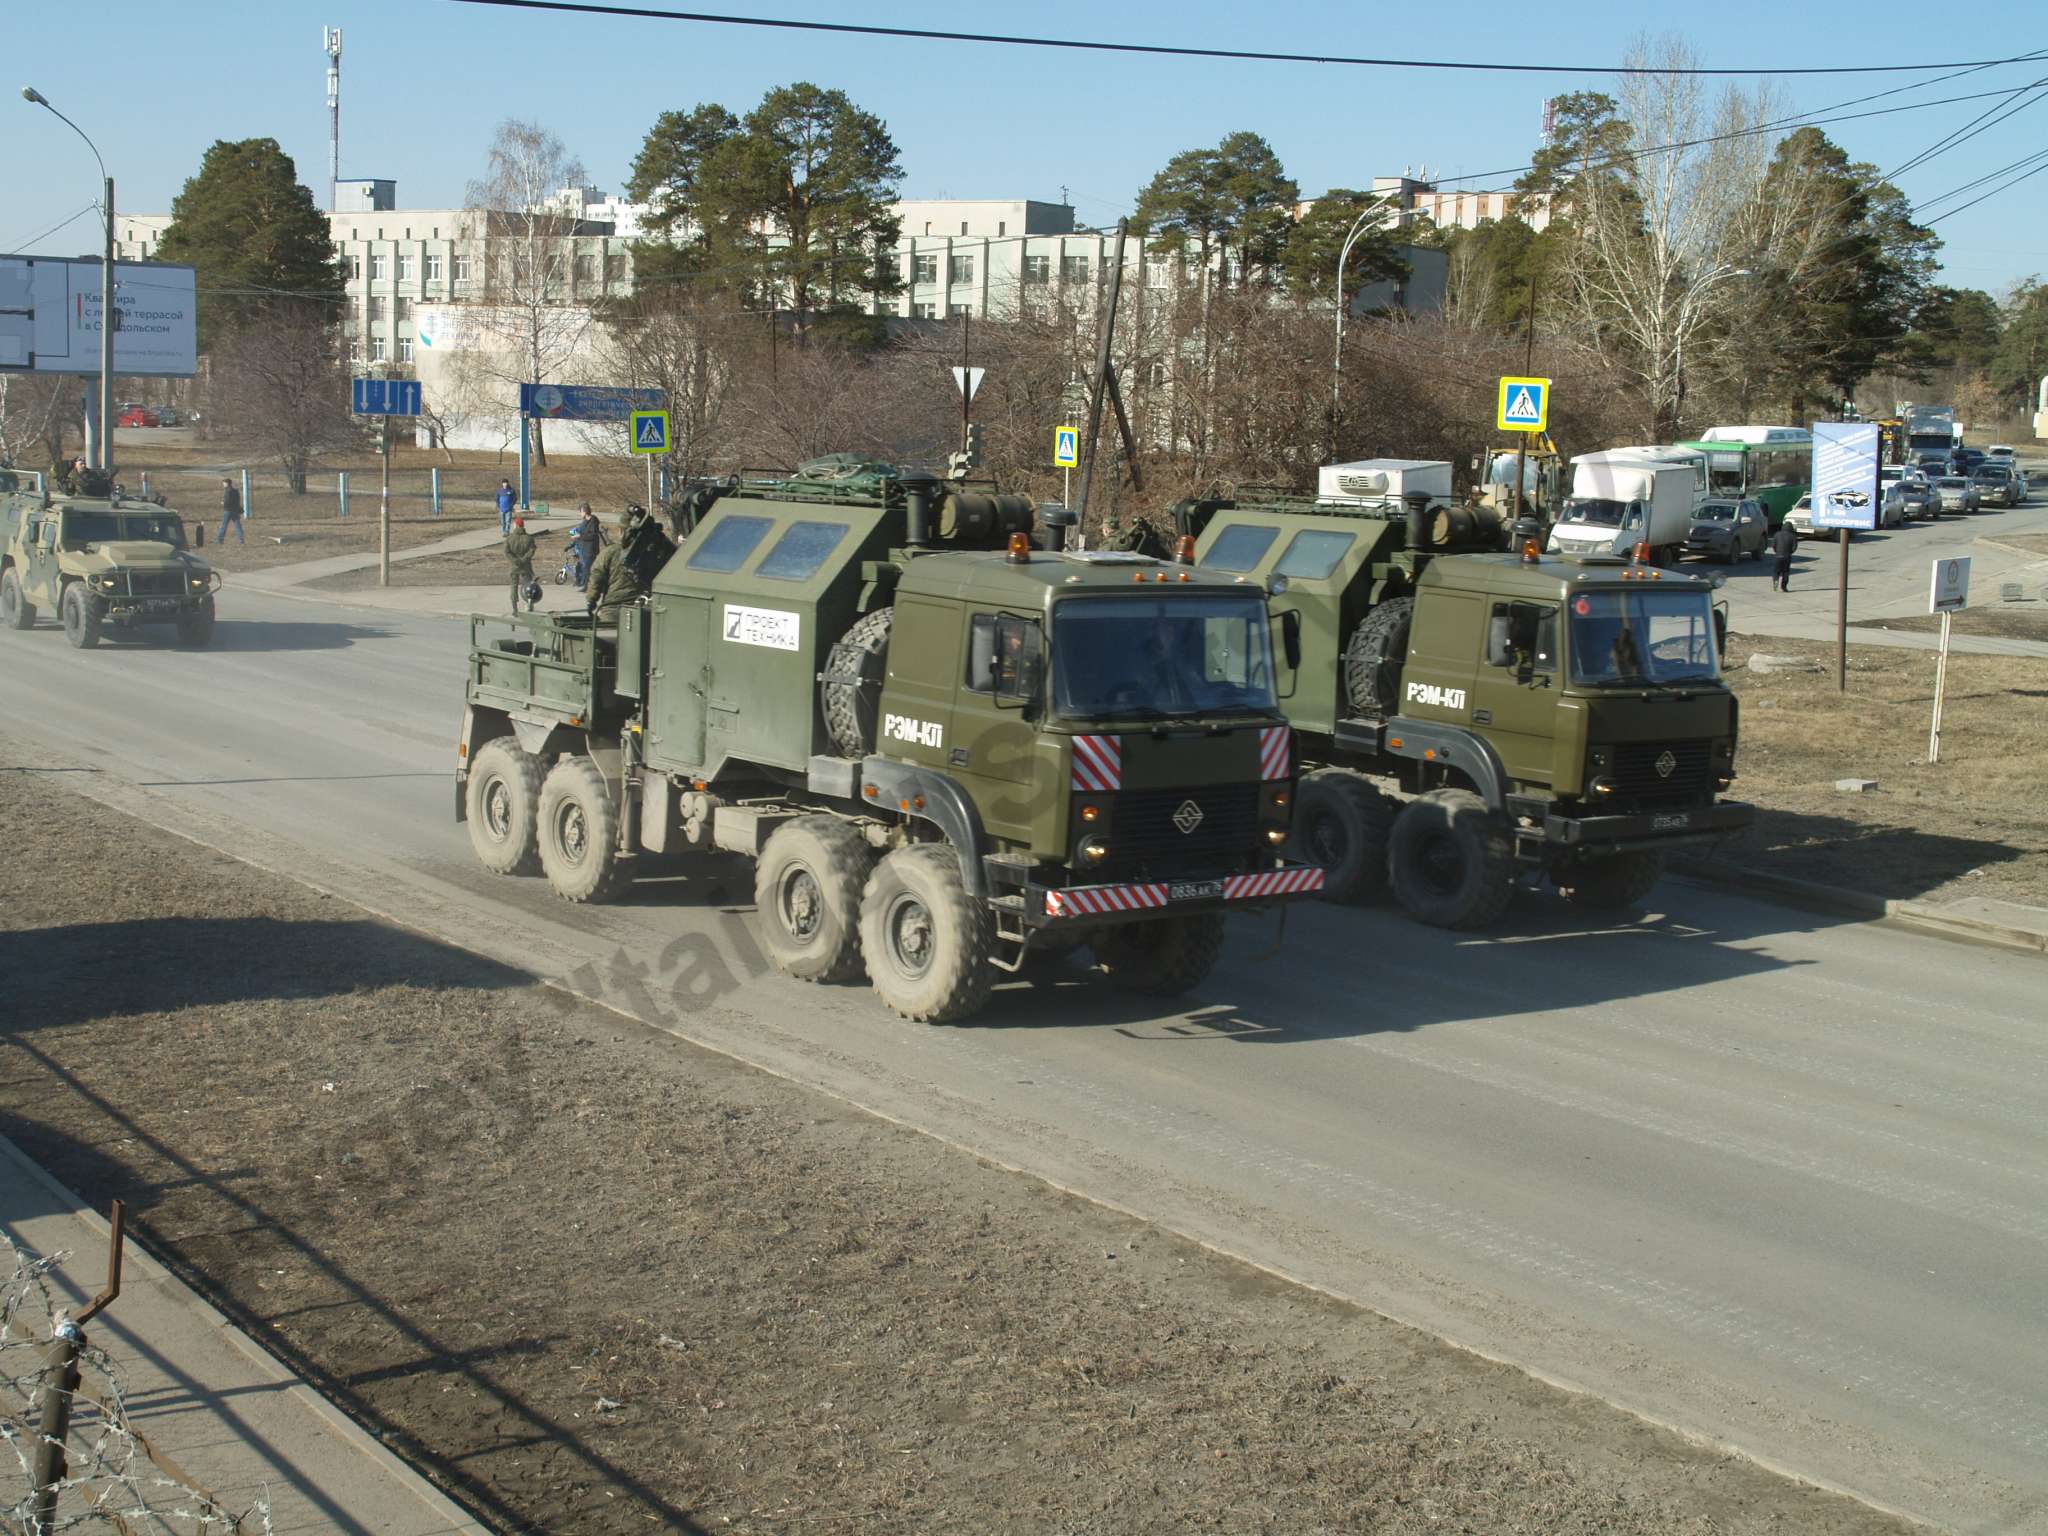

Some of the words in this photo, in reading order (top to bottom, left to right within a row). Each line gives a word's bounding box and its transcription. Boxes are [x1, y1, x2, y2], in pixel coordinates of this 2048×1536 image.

[135, 310, 183, 321] террасой
[745, 614, 790, 630] ПРОЕКТ
[745, 628, 797, 646] ТЕХНИКА
[1407, 682, 1466, 710] РЭМ-КЛ
[884, 713, 943, 748] РЭМ-КЛ
